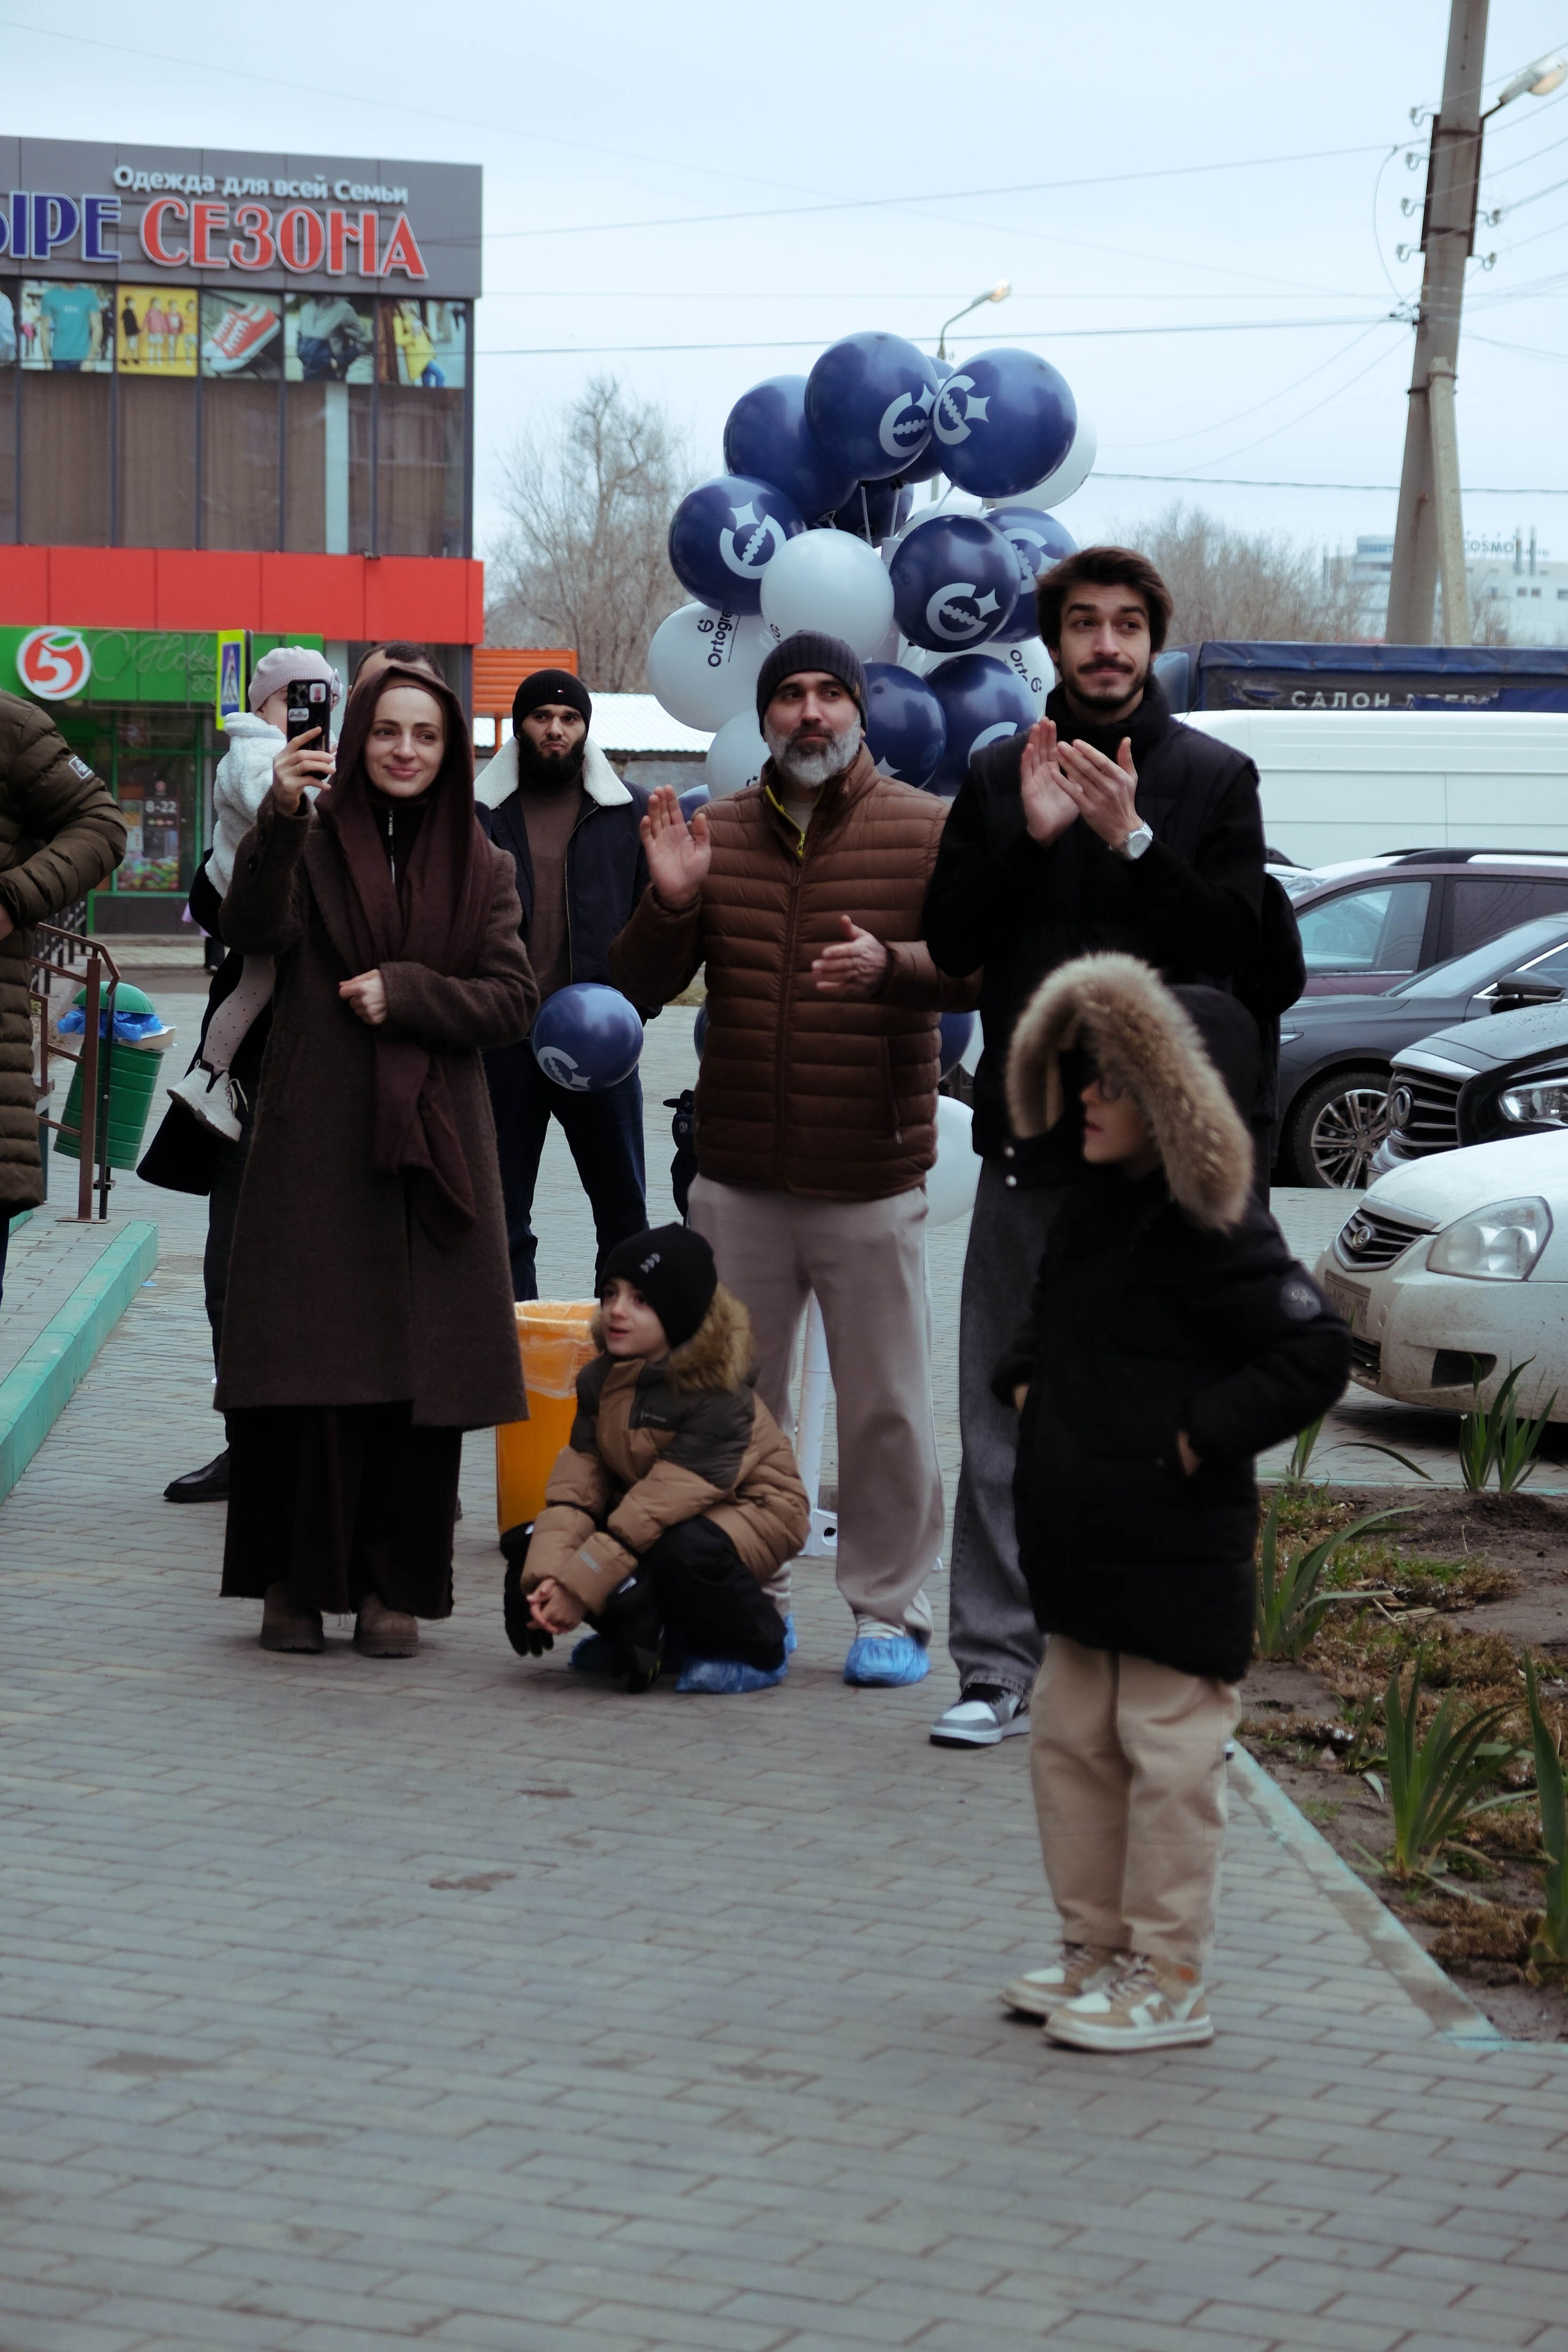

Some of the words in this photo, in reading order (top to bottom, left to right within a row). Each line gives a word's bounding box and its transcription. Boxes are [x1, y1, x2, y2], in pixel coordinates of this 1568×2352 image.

[114, 165, 215, 195] Одежда
[222, 176, 270, 198] для
[273, 173, 328, 200] всей
[334, 179, 409, 205] Семьи
[140, 196, 429, 280] СЕЗОНА
[1291, 690, 1390, 709] САЛОН
